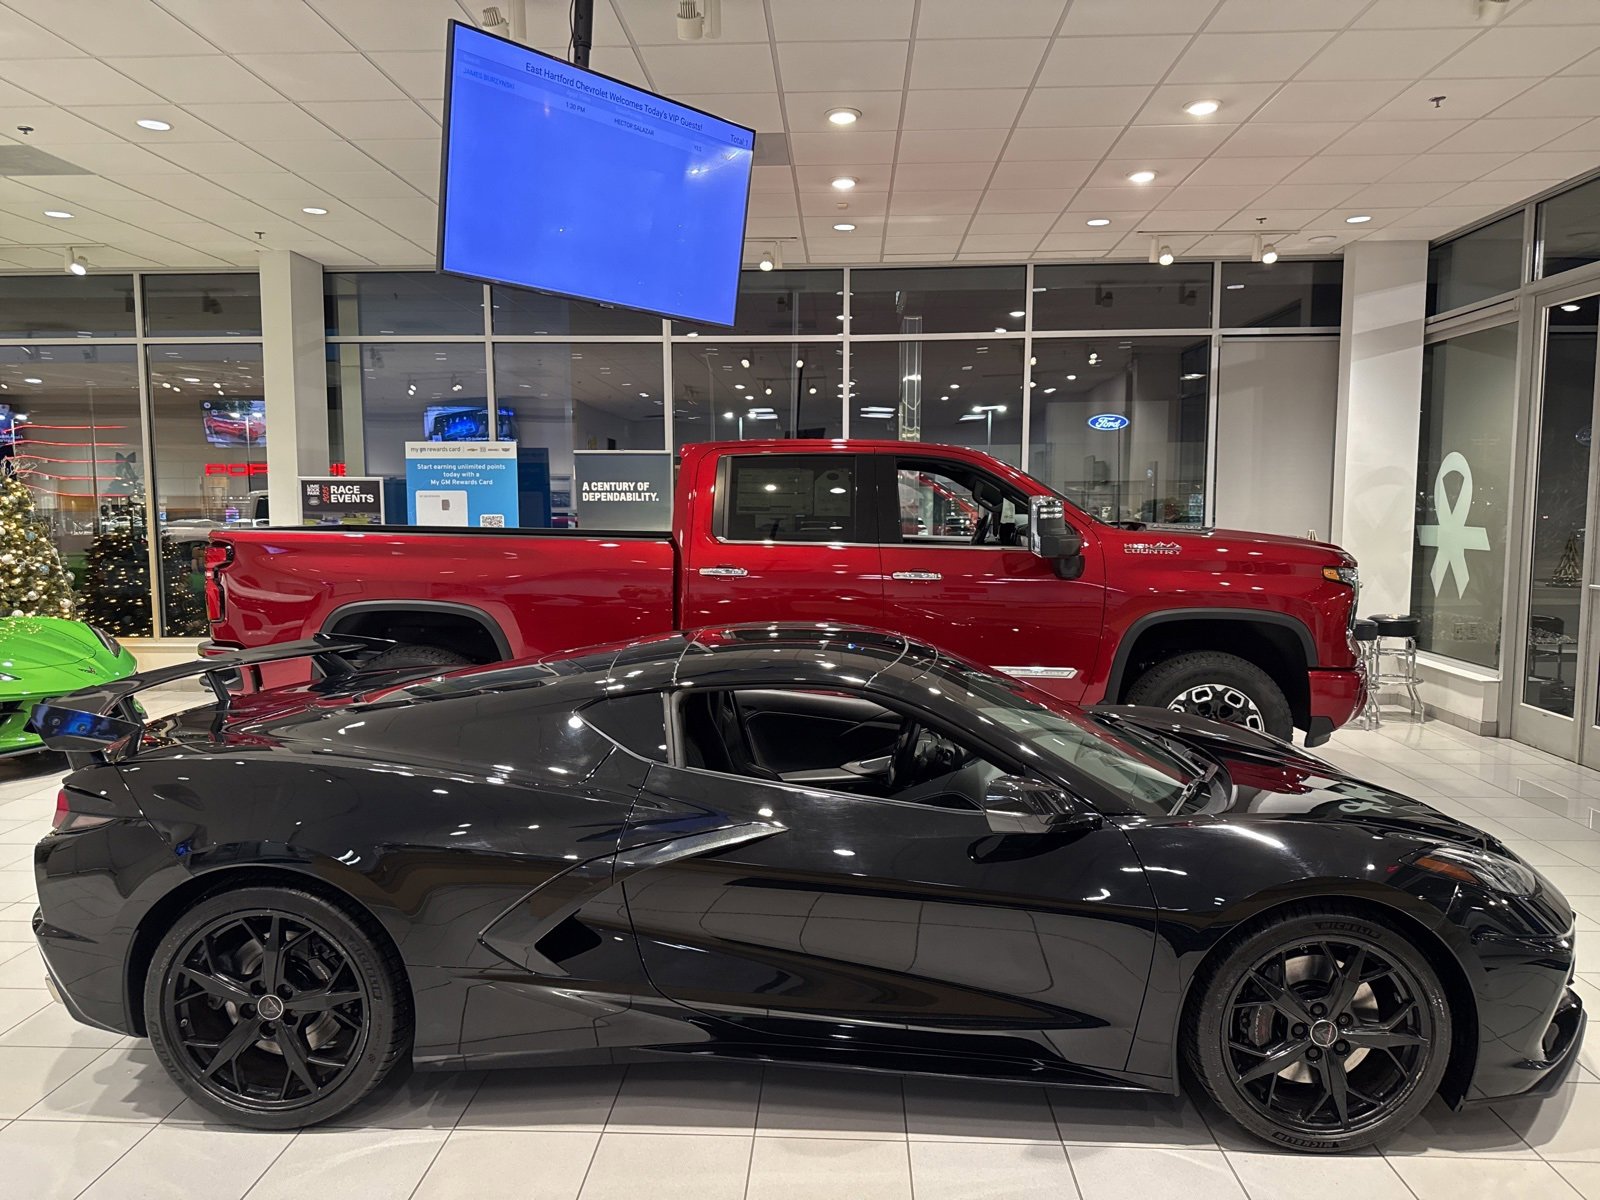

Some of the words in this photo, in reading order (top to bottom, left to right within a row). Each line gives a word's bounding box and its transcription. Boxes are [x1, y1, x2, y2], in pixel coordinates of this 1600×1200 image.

[525, 62, 543, 76] East
[544, 67, 574, 87] Hartford
[575, 80, 608, 98] Chevrolet
[609, 92, 643, 111] Welcomes
[644, 104, 668, 120] Today's
[669, 112, 680, 123] VIP
[680, 117, 703, 131] Guests!
[486, 463, 506, 471] points
[330, 485, 361, 494] RACE
[582, 481, 590, 491] A
[591, 481, 636, 491] CENTURY
[637, 481, 650, 491] OF
[330, 494, 375, 503] EVENTS
[582, 492, 660, 502] DEPENDABILITY.
[1276, 1132, 1335, 1149] MICHELIN
